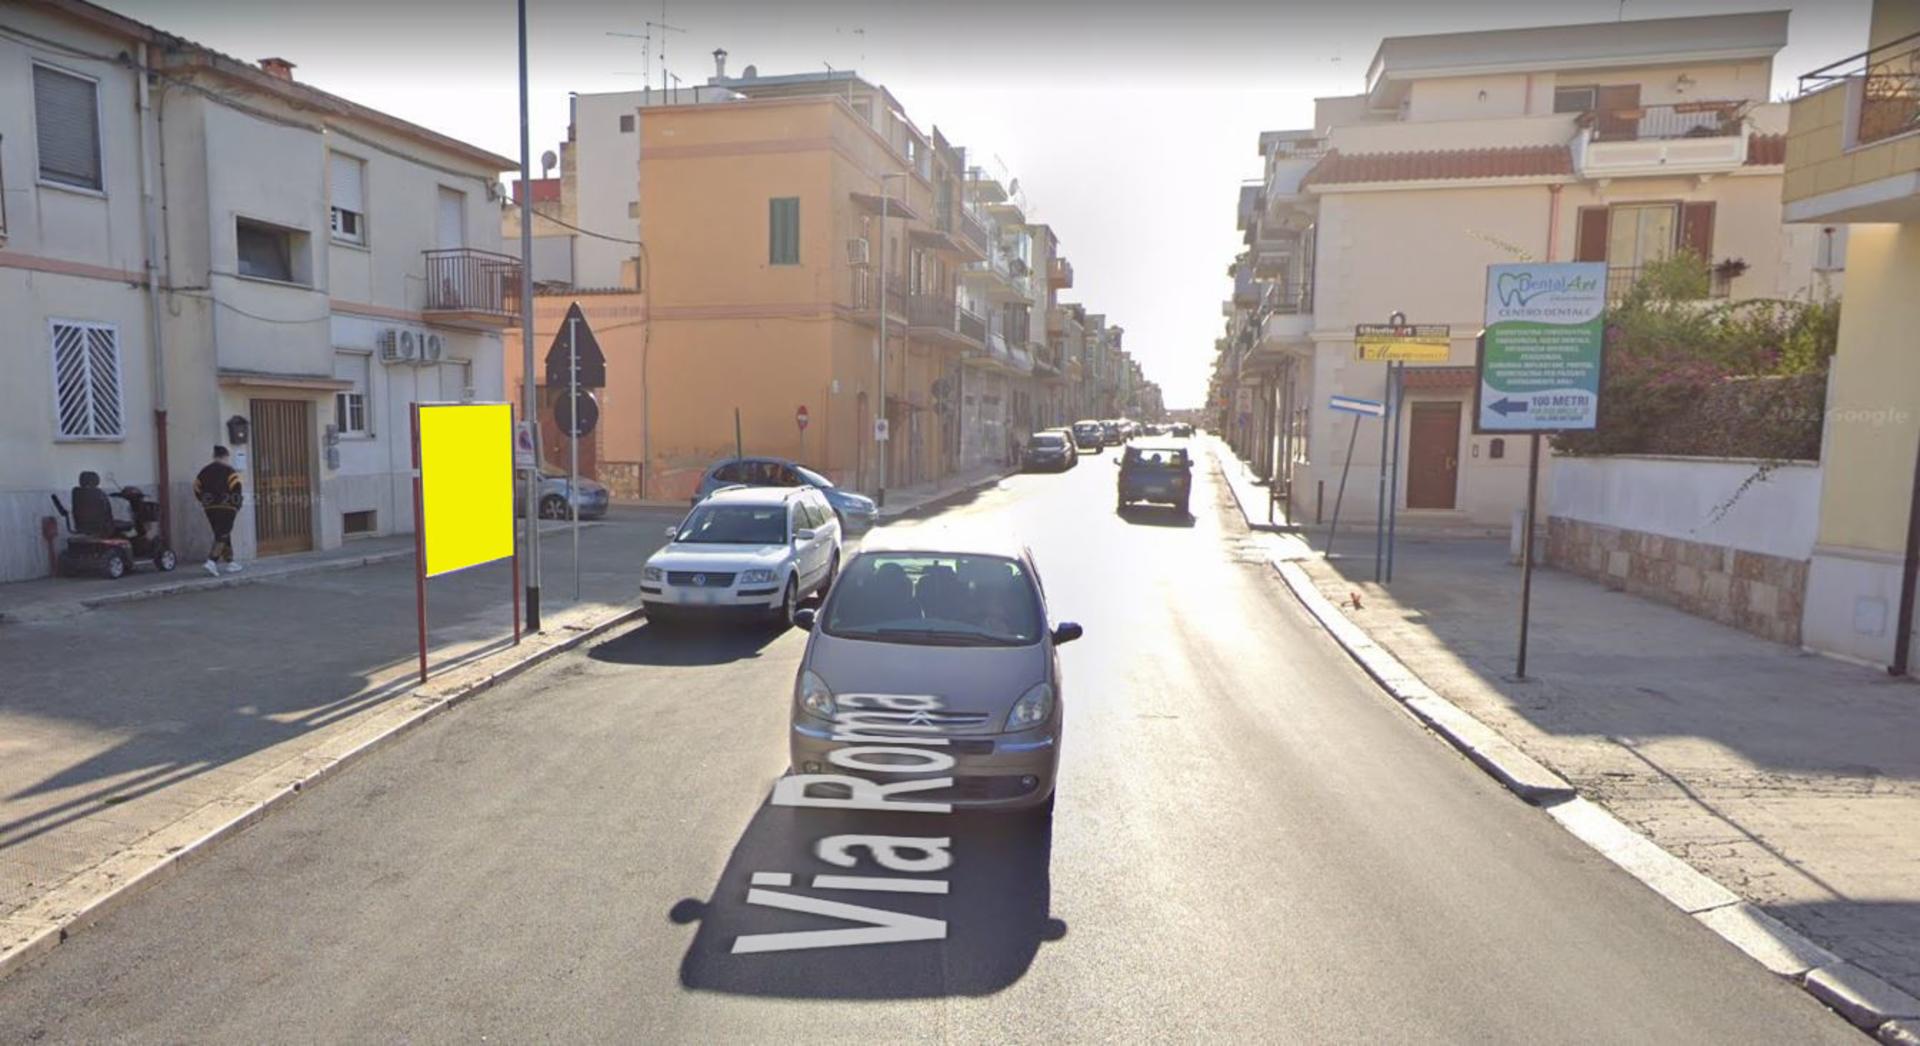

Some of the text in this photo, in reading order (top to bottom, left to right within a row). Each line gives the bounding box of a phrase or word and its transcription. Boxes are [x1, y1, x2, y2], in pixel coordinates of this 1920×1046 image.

[1498, 307, 1542, 317] CENTRO
[1532, 395, 1589, 406] 100 METRI
